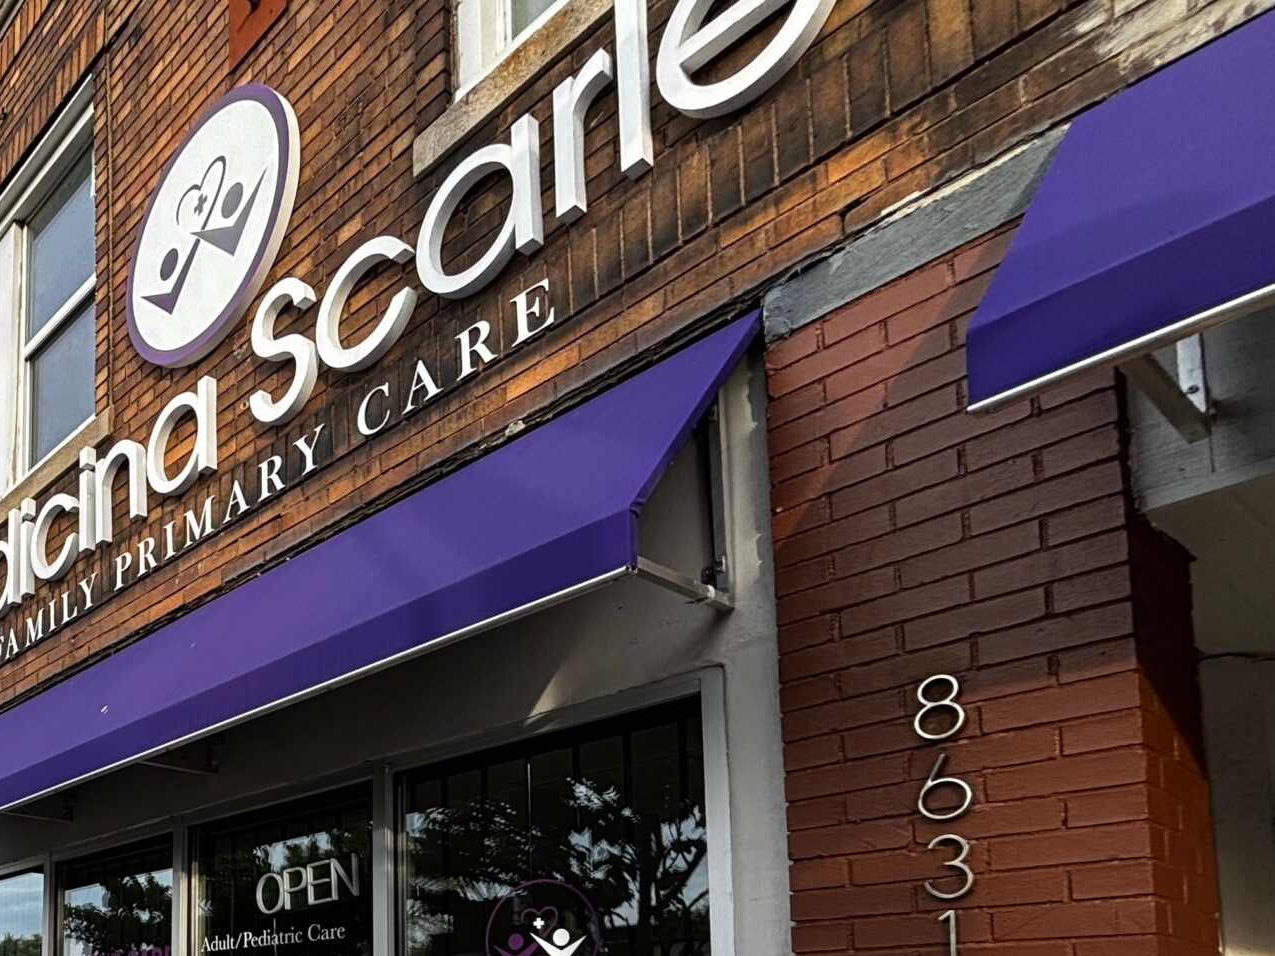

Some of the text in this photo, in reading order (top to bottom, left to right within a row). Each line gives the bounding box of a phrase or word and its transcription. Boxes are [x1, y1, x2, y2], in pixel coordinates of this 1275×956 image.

[114, 423, 326, 592] PRIMARY
[356, 278, 555, 437] CARE
[256, 853, 360, 914] OPEN
[201, 923, 346, 952] Adult/Pediatric Care
